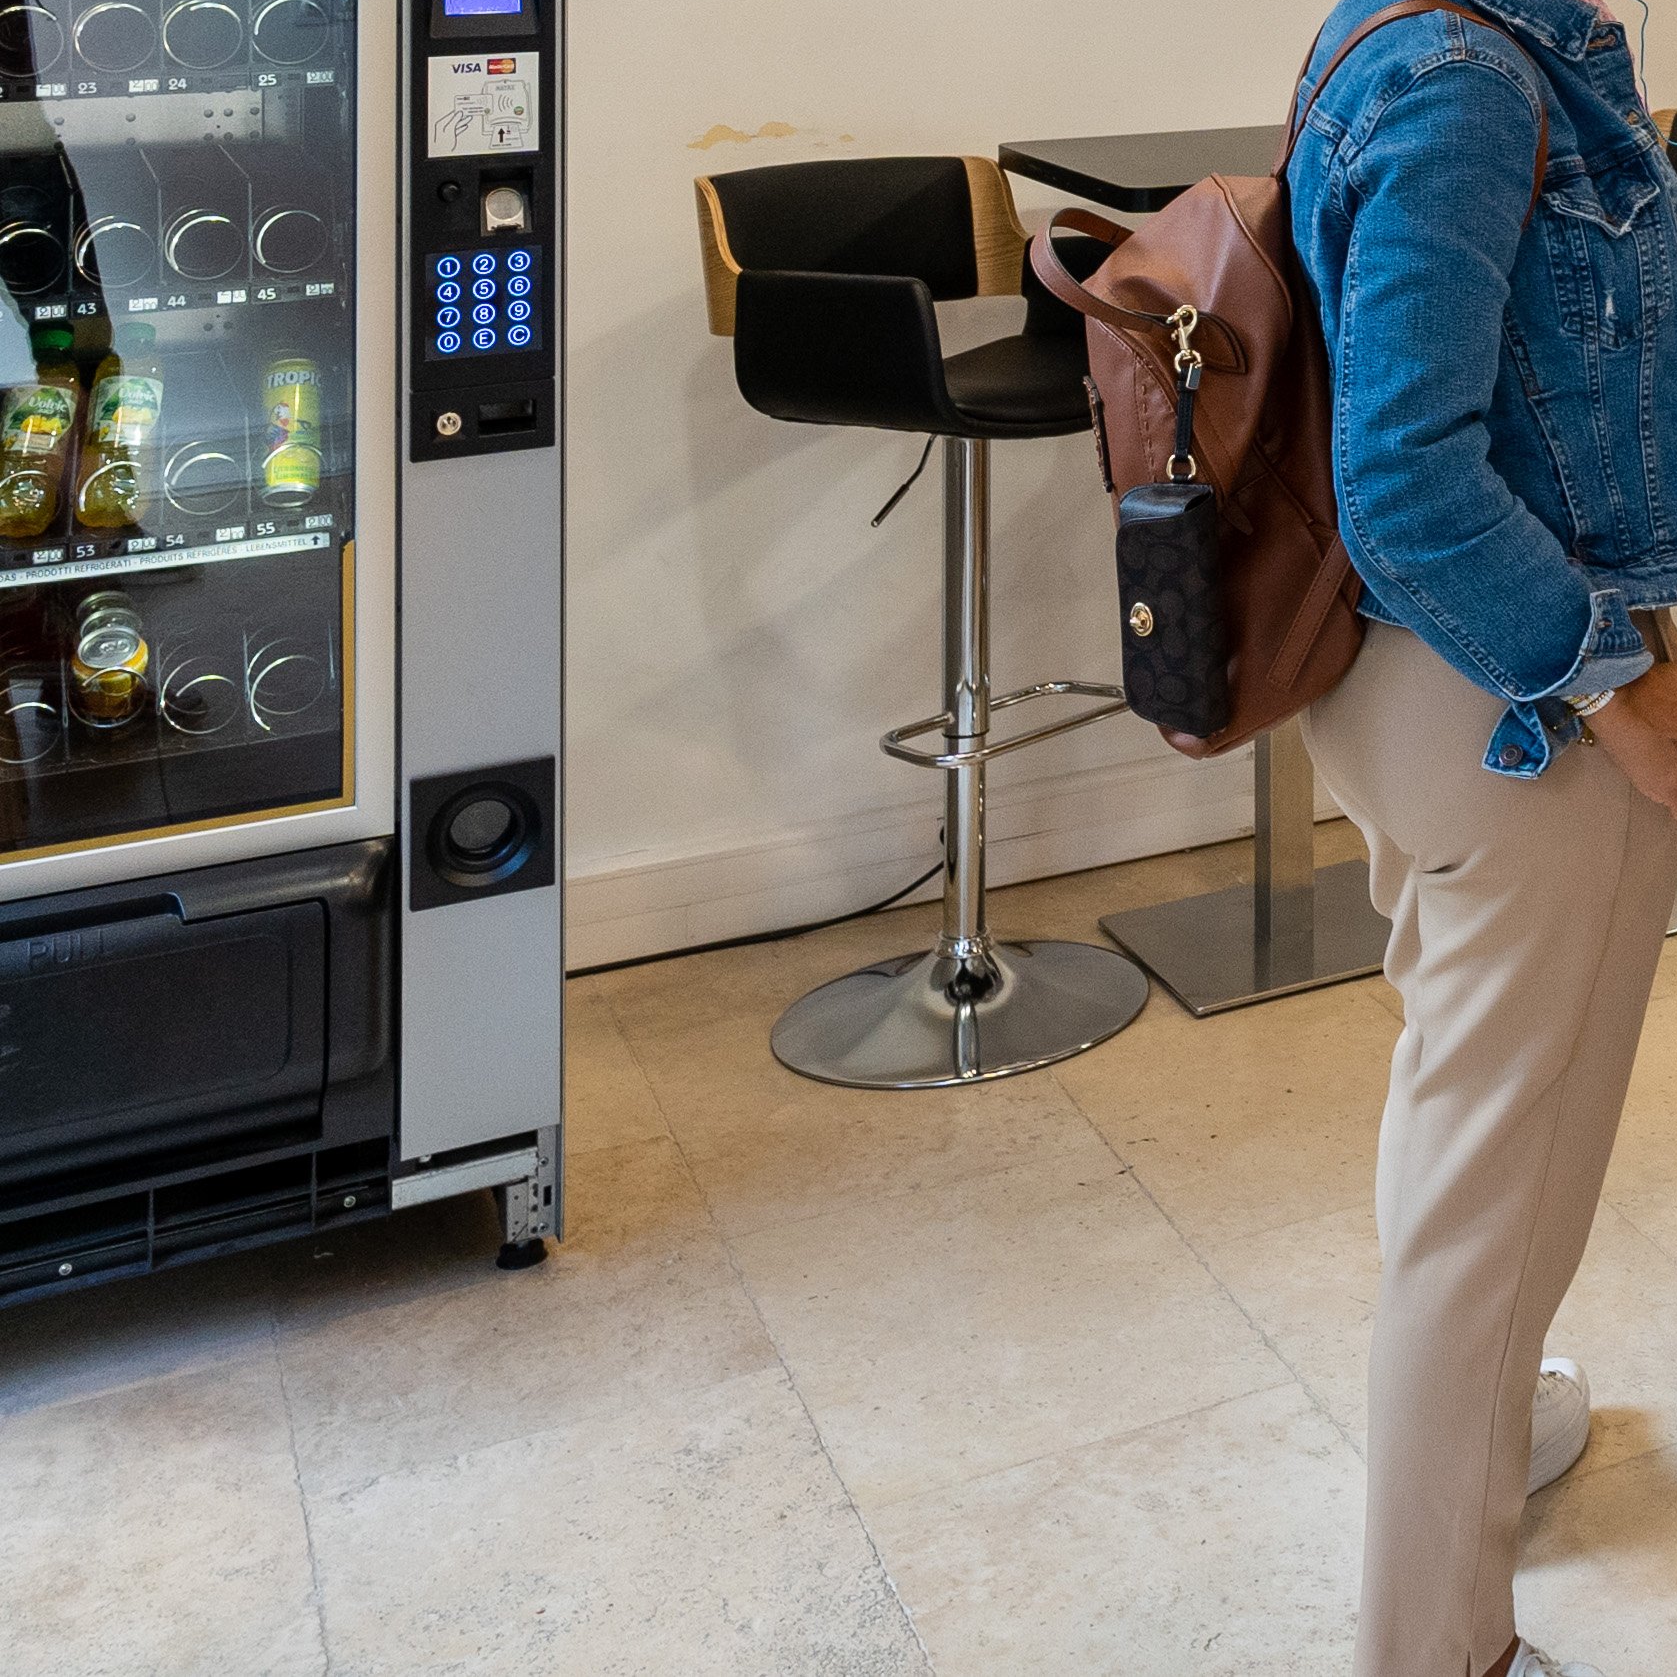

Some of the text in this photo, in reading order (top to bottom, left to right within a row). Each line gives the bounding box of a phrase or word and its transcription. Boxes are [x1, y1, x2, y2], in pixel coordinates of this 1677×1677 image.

[452, 63, 481, 74] VISA
[168, 78, 187, 90] 24
[258, 74, 277, 86] 25
[78, 82, 97, 94] 23
[257, 288, 276, 300] 45
[167, 295, 186, 307] 44
[77, 303, 97, 315] 43
[257, 522, 276, 535] 55
[166, 534, 185, 546] 54
[76, 545, 96, 558] 53
[26, 567, 71, 579] PRODOTTI
[140, 552, 183, 565] PRODUITS
